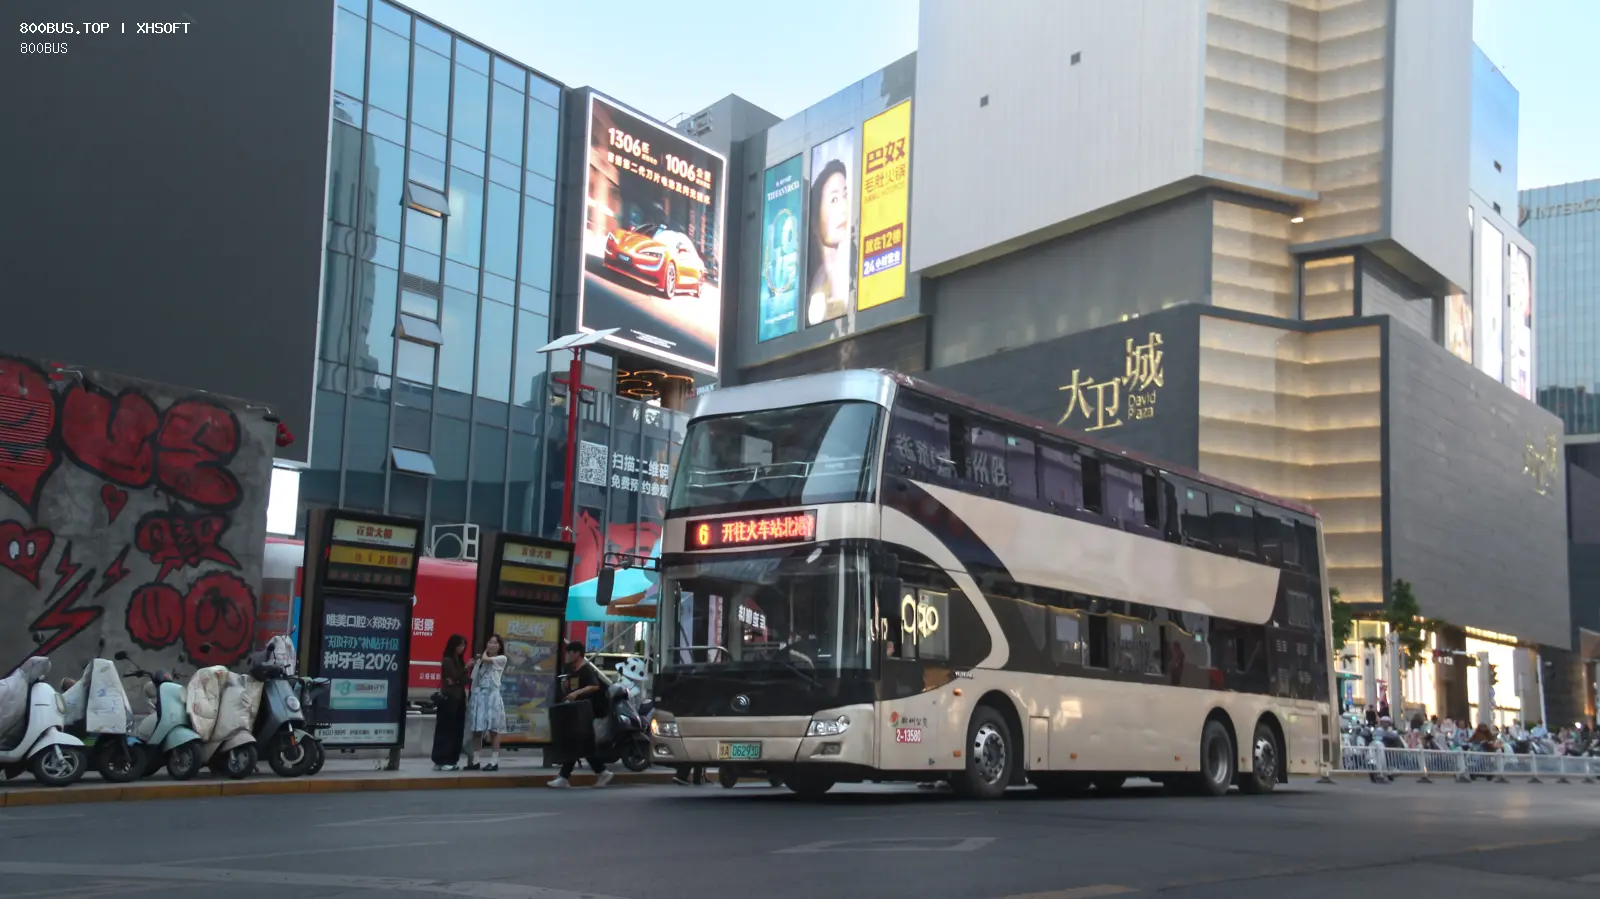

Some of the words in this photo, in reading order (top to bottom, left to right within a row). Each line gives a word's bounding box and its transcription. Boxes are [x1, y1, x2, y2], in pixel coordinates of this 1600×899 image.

[865, 136, 906, 175] 巴奴
[1127, 389, 1156, 408] David
[612, 451, 669, 480] 扫描二维码
[698, 523, 711, 546] 6
[412, 618, 434, 632] 彩票
[323, 651, 398, 672] 种牙省20%
[896, 728, 922, 742] 2-13580
